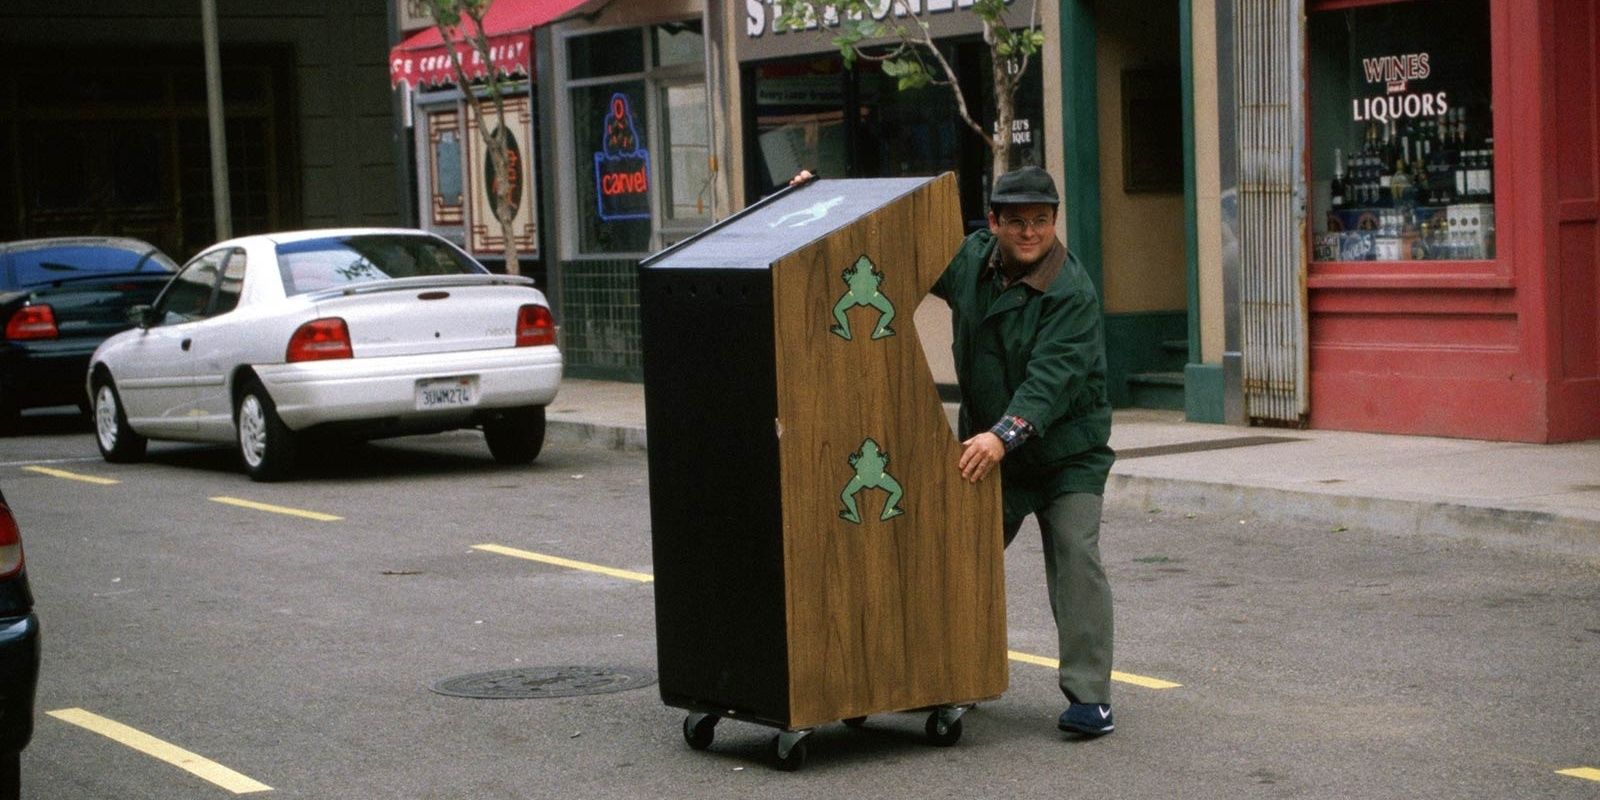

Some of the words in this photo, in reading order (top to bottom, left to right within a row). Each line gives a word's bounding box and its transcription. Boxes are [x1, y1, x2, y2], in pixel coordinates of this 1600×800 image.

[391, 58, 414, 74] CE
[471, 40, 524, 65] BKERY
[1362, 53, 1430, 83] WINES
[1352, 91, 1448, 124] LIQUORS
[602, 168, 648, 195] carvel
